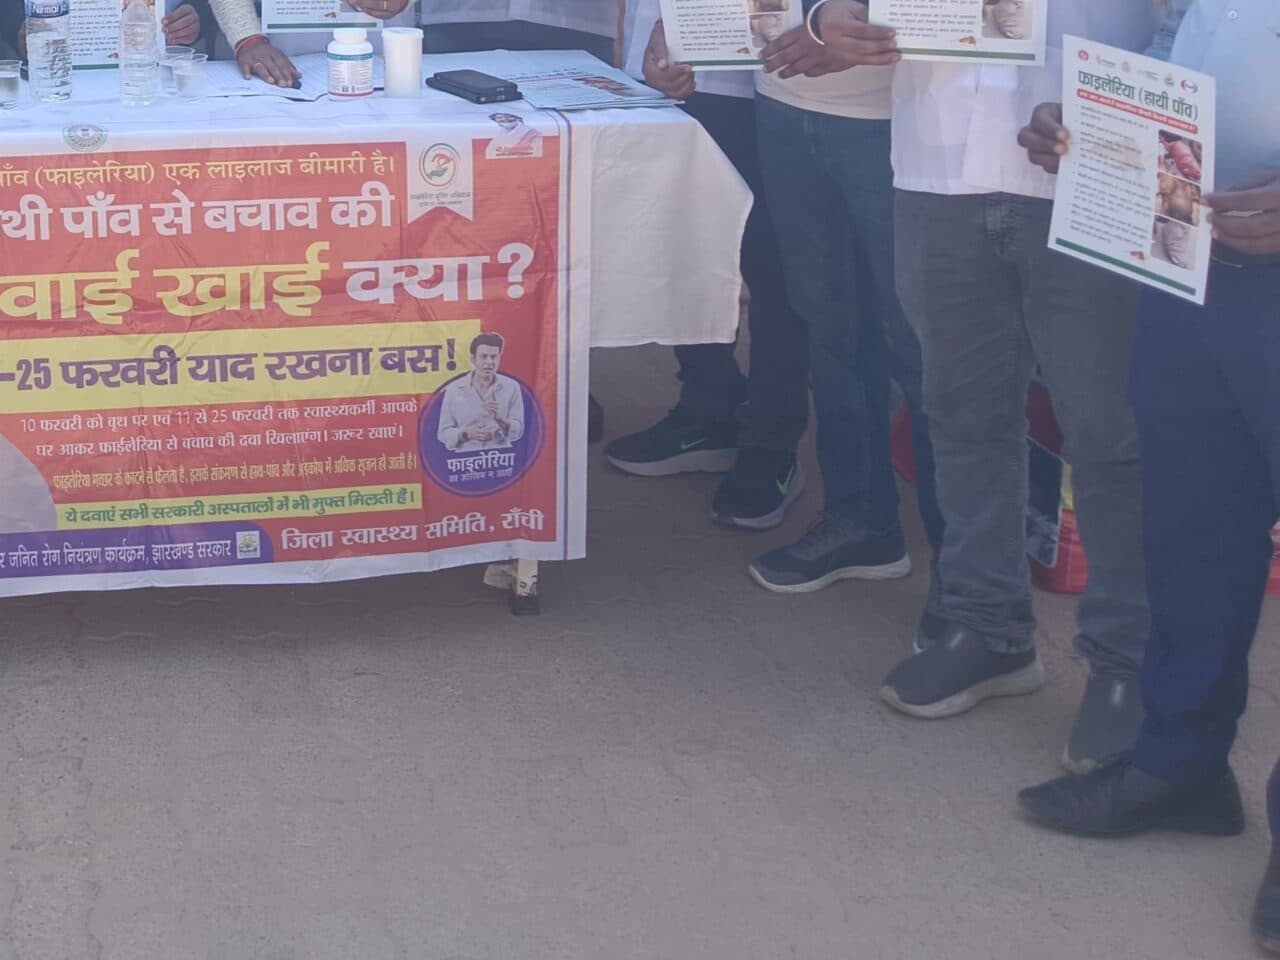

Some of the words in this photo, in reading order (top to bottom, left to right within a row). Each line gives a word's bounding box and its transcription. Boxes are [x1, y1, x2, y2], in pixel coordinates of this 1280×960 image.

[1078, 70, 1135, 100] फाइलेरिया
[35, 161, 155, 189] (फाइलेरिया)
[162, 162, 200, 185] एक
[207, 158, 291, 181] लाइलाज
[298, 151, 365, 175] बीमारी
[369, 149, 394, 175] है।
[60, 191, 143, 238] पाँव
[150, 189, 195, 236] से
[202, 198, 320, 232] बचाव
[329, 180, 395, 228] की
[153, 241, 330, 317] खाई
[343, 242, 534, 304] क्या?
[59, 345, 181, 389] फरवरी
[186, 353, 258, 383] याद
[264, 347, 373, 381] रखना
[21, 418, 36, 432] 10
[40, 415, 82, 432] फरवरी
[87, 413, 104, 430] को
[132, 415, 147, 425] पर
[176, 411, 191, 424] 11
[195, 409, 207, 424] से
[212, 409, 227, 423] 25
[233, 405, 272, 422] फरवरी
[278, 407, 299, 420] तक
[304, 400, 376, 418] स्वास्थ्यकर्मी
[381, 399, 417, 415] आपके
[36, 444, 53, 457] घर
[59, 443, 94, 456] आकर
[167, 434, 178, 450] से
[182, 437, 214, 449] बचाव
[218, 432, 235, 448] की
[240, 433, 261, 447] दवा
[447, 451, 515, 474] फाइलेरिया
[66, 506, 77, 523] ये
[81, 504, 116, 522] दवाएं
[120, 502, 149, 520] सभी
[152, 500, 204, 519] सरकारी
[293, 494, 309, 510] भी
[313, 494, 345, 514] मुफ्त
[347, 489, 393, 507] मिलती
[281, 527, 332, 550] जिला
[341, 525, 418, 547] स्वास्थ्य
[424, 512, 495, 539] समिति,
[501, 507, 544, 531] राँची
[9, 545, 38, 566] जनित
[42, 544, 61, 567] रोग
[64, 540, 101, 566] नियंत्रण
[152, 542, 194, 566] झारखण्ड
[197, 539, 232, 558] सरकार
